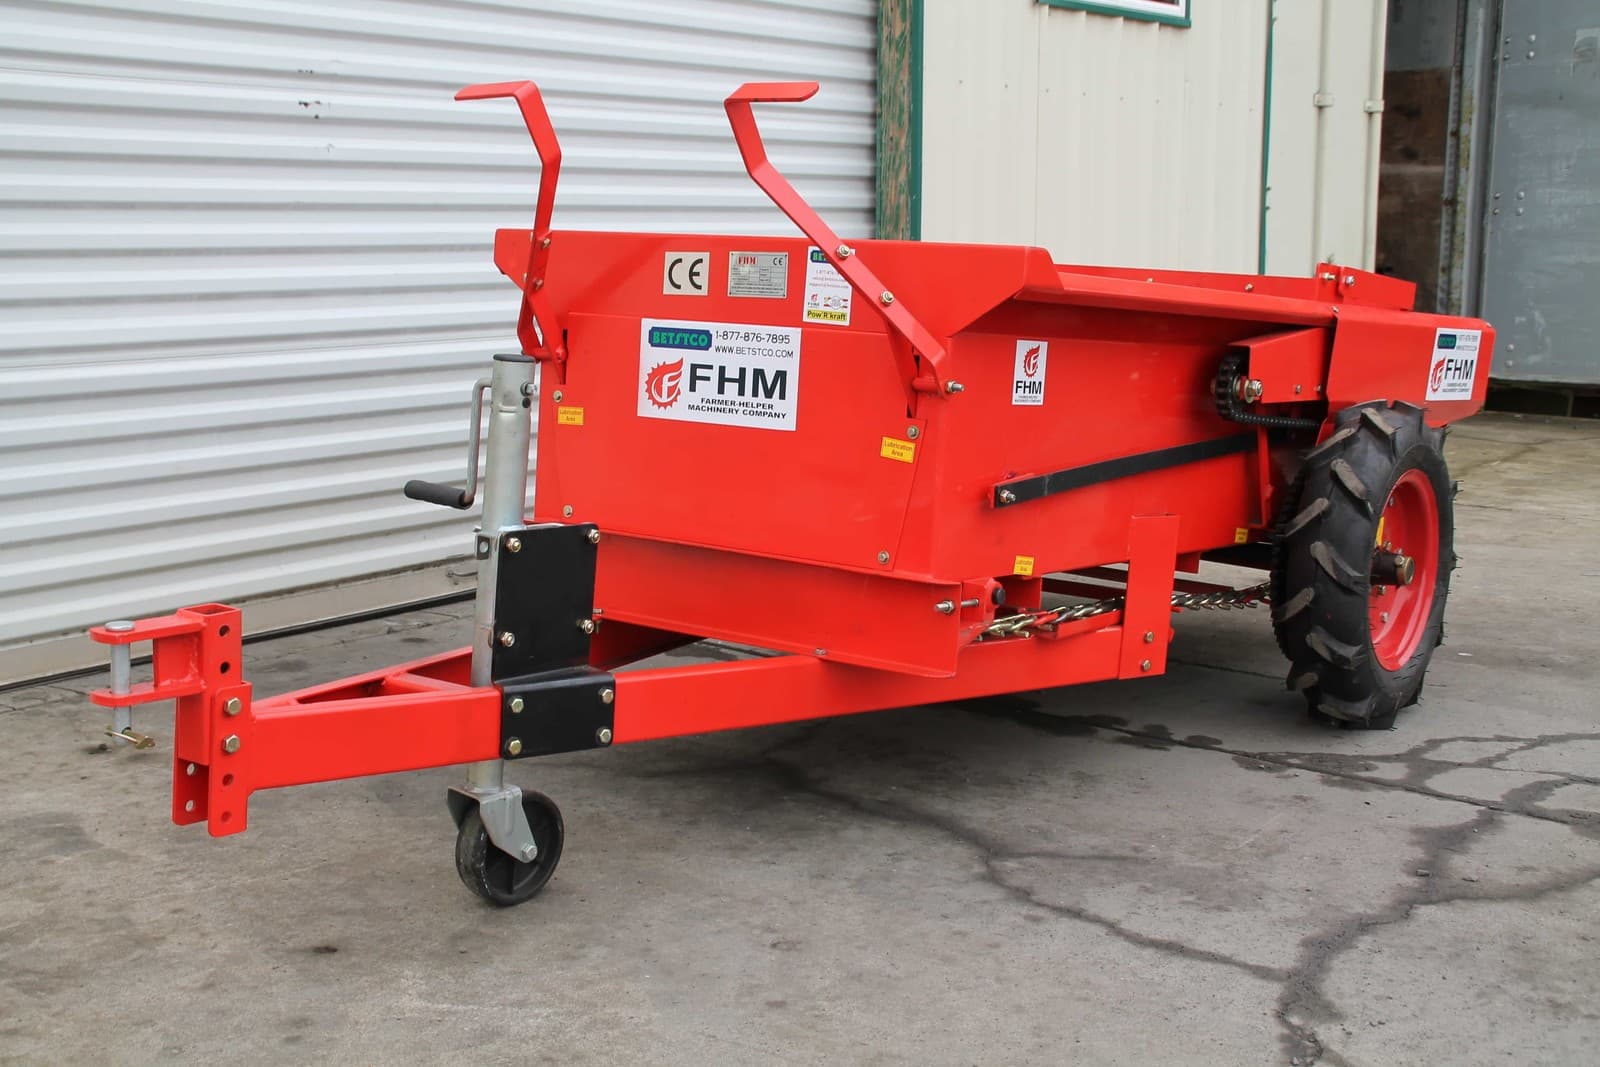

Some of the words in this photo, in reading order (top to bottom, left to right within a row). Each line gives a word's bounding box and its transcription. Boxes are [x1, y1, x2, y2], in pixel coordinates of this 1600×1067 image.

[738, 256, 756, 265] FHM
[772, 257, 784, 266] CE
[668, 258, 703, 290] CE
[652, 331, 708, 347] BETSTCO
[715, 330, 791, 344] 1-877-876-7895
[714, 345, 794, 358] WWW.BETSTCO.COM
[1444, 358, 1474, 380] FHM
[689, 363, 787, 400] FHM
[1015, 380, 1042, 394] FHM
[700, 398, 774, 410] FARMER-HELPER
[688, 404, 740, 415] MACHINERY
[742, 408, 787, 419] COMPANY
[884, 439, 913, 452] Lubrication
[891, 449, 904, 457] Area
